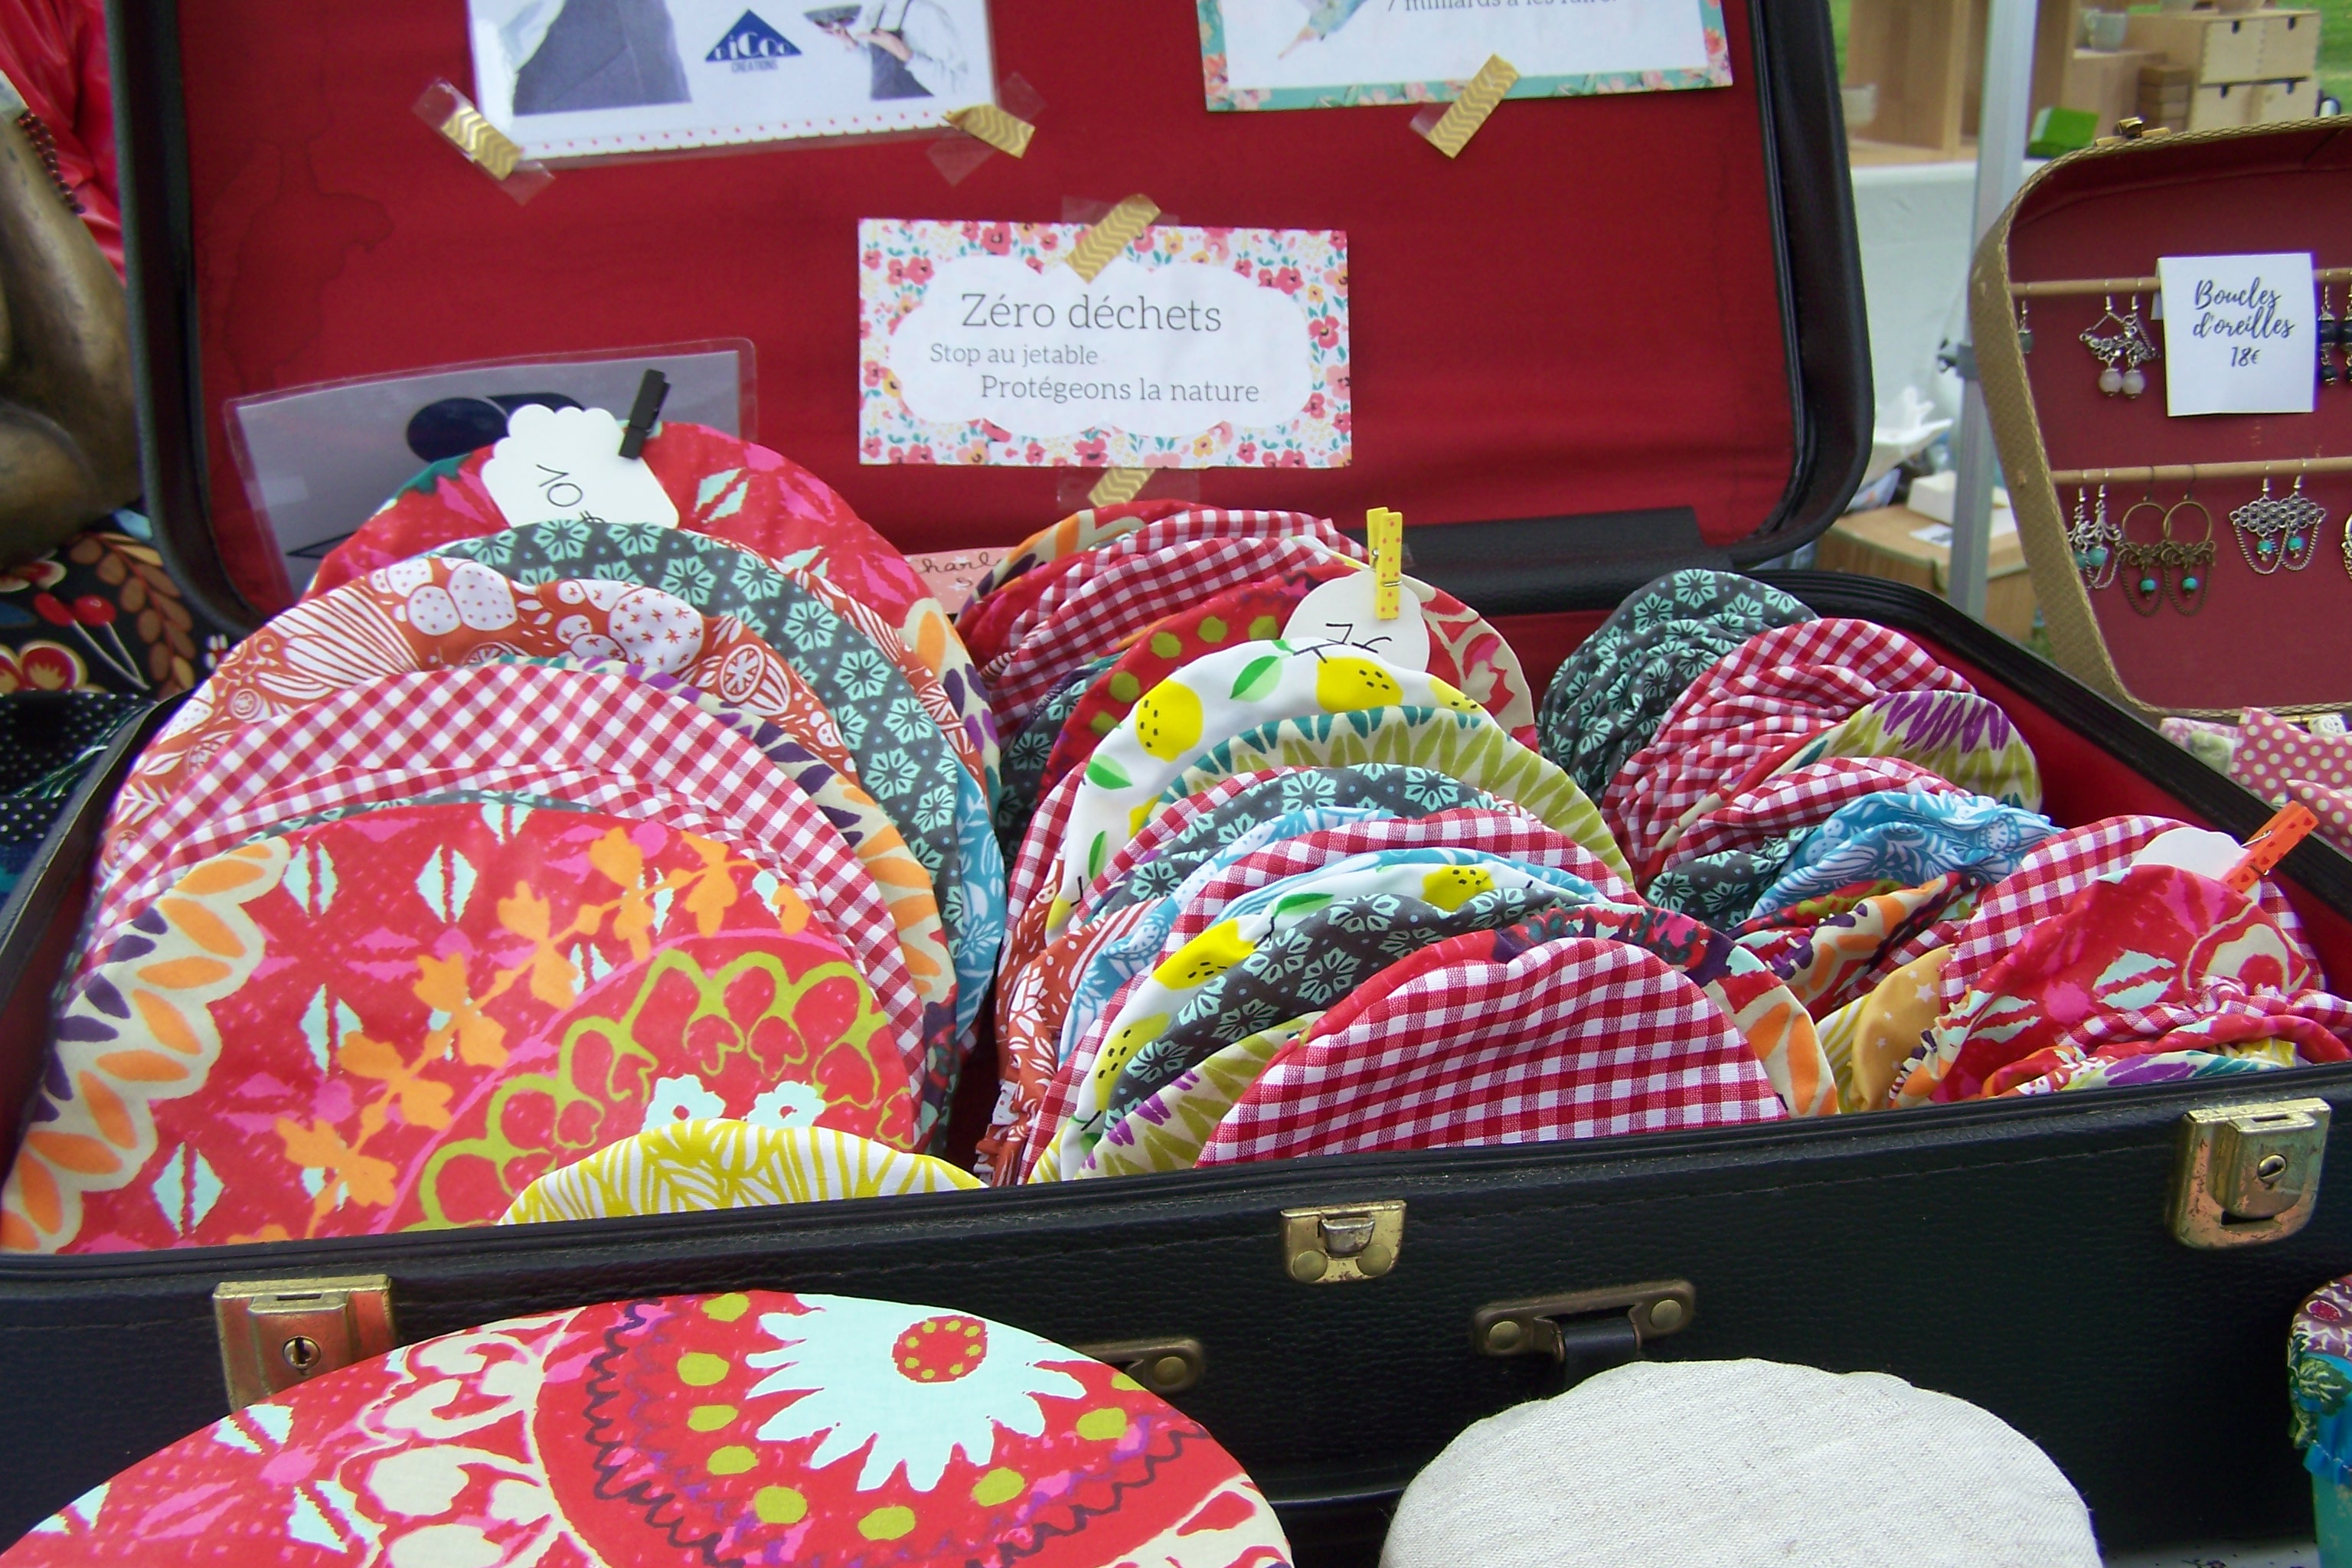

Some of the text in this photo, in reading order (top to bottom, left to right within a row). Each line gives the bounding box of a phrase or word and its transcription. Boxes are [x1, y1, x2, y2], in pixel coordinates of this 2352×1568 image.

[2194, 276, 2282, 310] Boucles
[962, 293, 1222, 332] Zéro déchets
[2192, 305, 2295, 340] d'oreilles
[929, 342, 1099, 368] Stop au jetable
[2230, 346, 2262, 368] 18€
[981, 374, 1260, 404] Protégeons la nature
[916, 550, 1004, 574] harl
